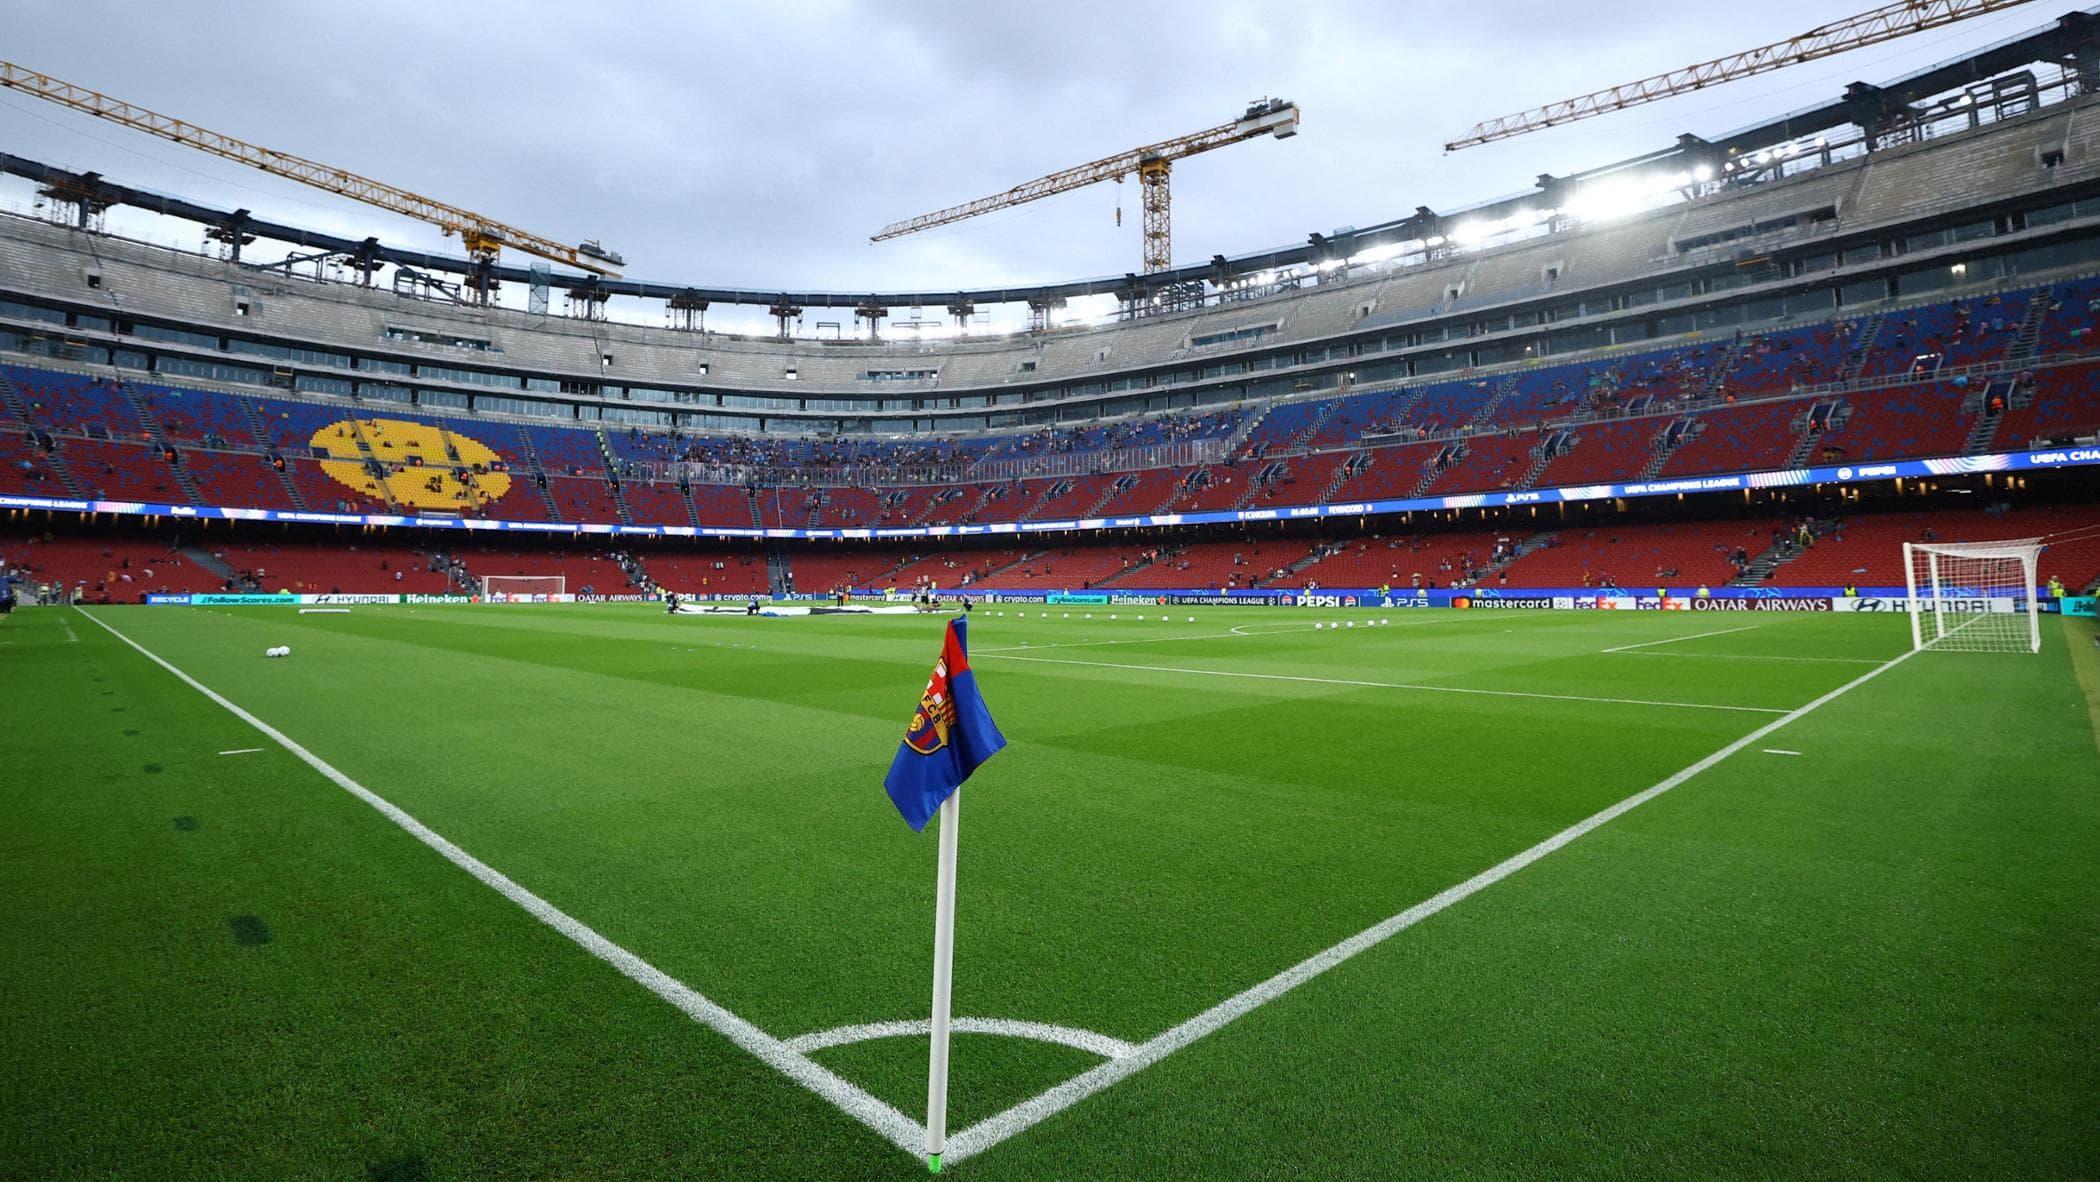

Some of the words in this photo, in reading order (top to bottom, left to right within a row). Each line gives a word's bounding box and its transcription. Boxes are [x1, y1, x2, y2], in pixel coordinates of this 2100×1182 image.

[2030, 453, 2067, 464] UEFA
[1624, 484, 1648, 493] UEFA
[1648, 480, 1702, 492] CHAMPIONS
[1702, 477, 1740, 488] LEAGUE
[151, 596, 188, 604] RECYCLE
[337, 596, 389, 604] HYUNDAI
[406, 594, 468, 604] Heineken
[577, 594, 606, 602] QATAR
[609, 594, 643, 602] AIRWAYS
[1003, 596, 1045, 605] crypto.com
[1111, 595, 1158, 605] Heineken
[1239, 597, 1265, 605] LEAGUE
[1296, 596, 1340, 607] PEPSI
[1397, 598, 1429, 607] PS5
[1472, 598, 1550, 608] mastercard
[1575, 598, 1617, 609] FedEx
[1637, 598, 1683, 610] FedEx
[1694, 599, 1748, 611] QATAR
[1754, 598, 1828, 611] AIRWAYS
[921, 694, 942, 724] FCB
